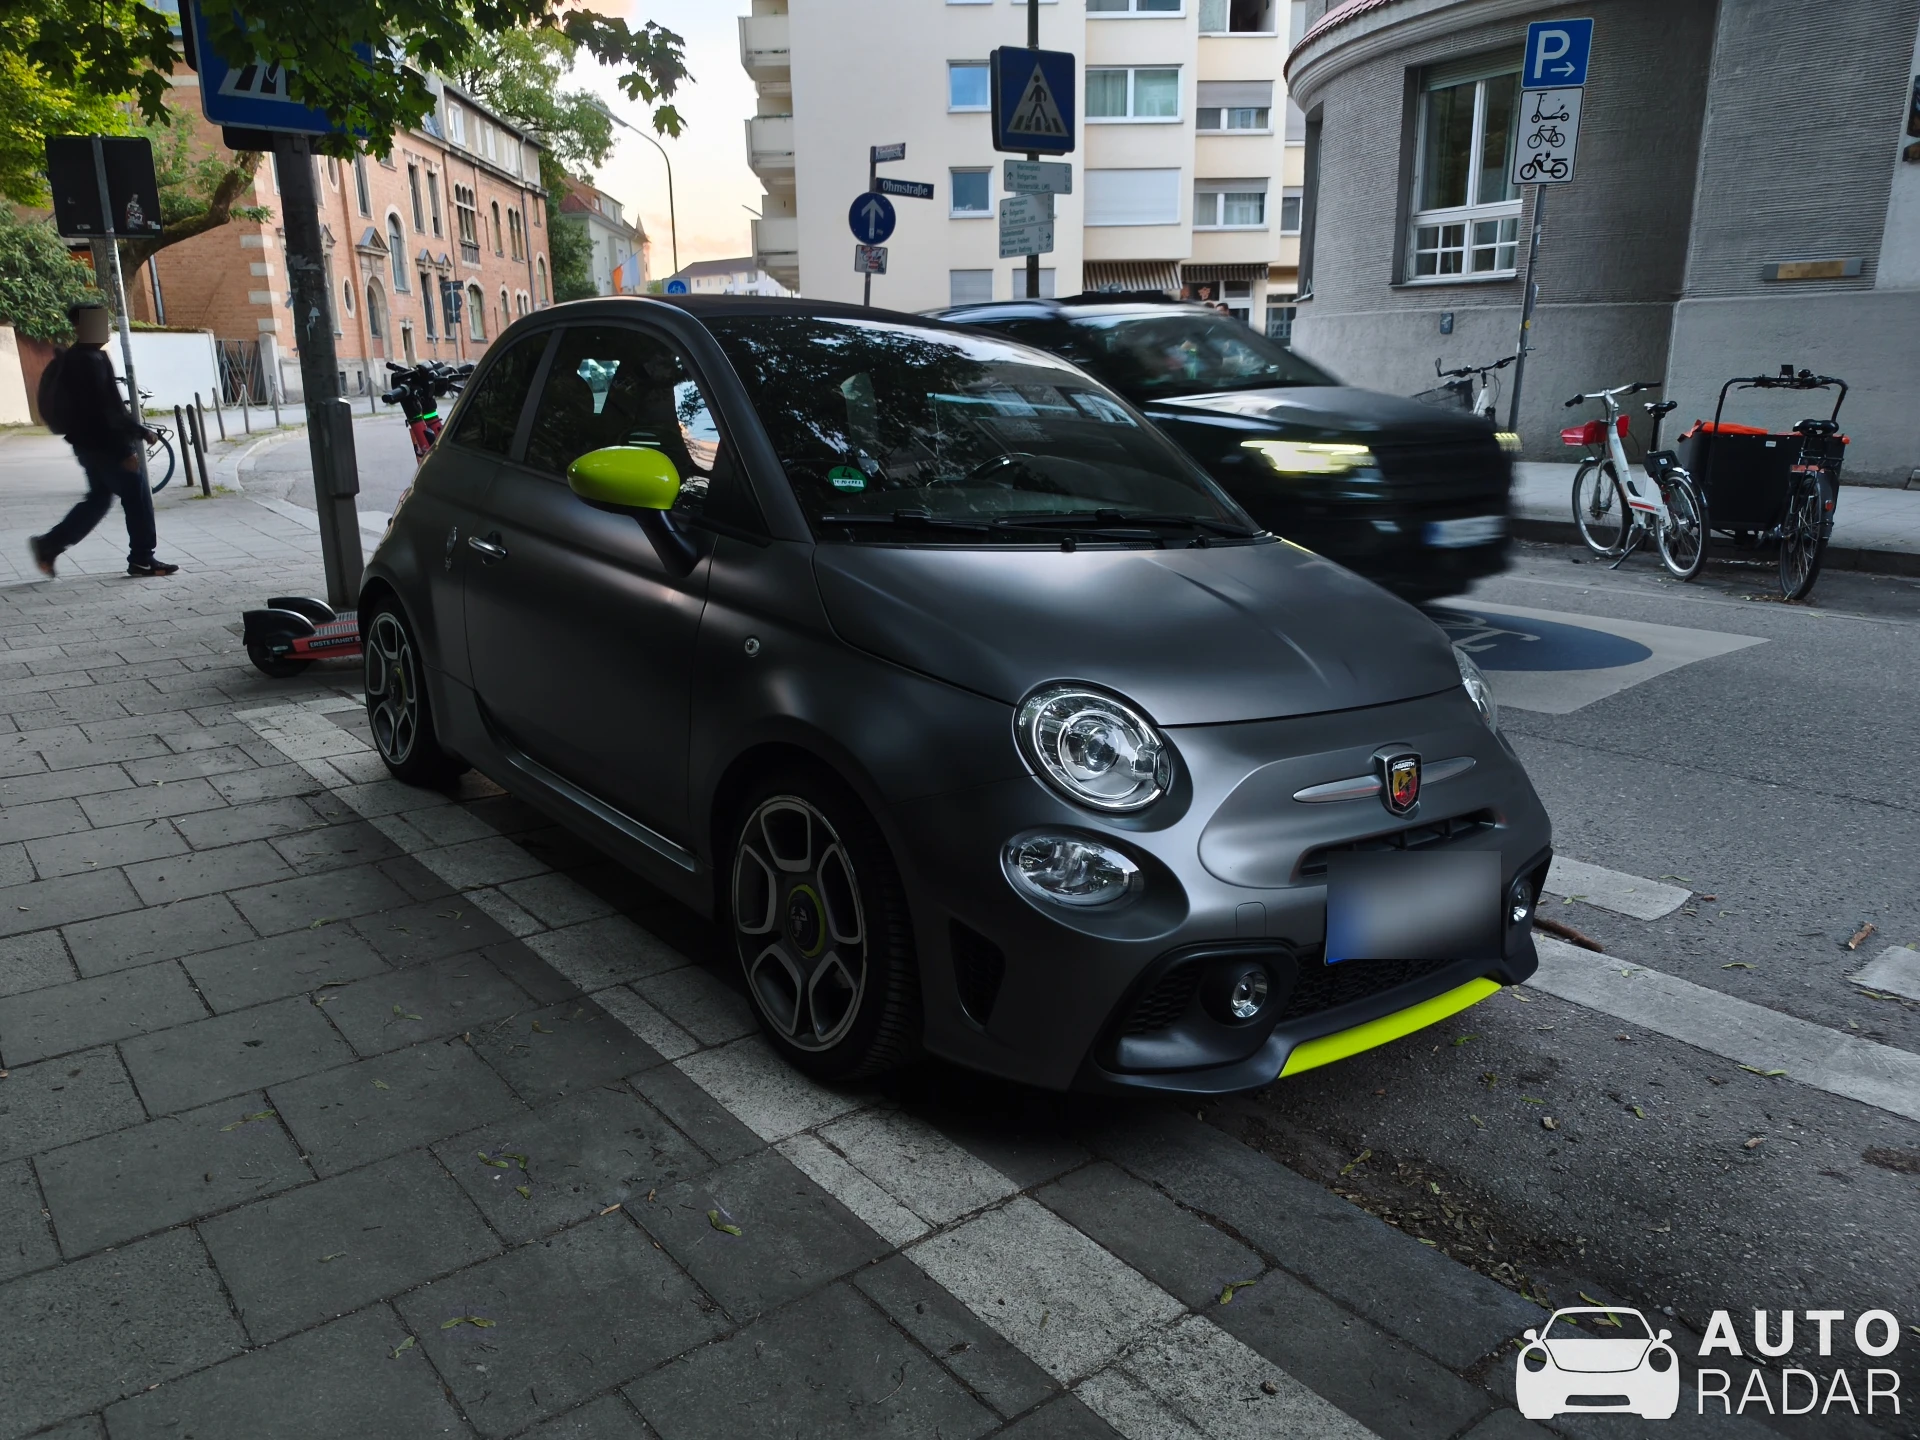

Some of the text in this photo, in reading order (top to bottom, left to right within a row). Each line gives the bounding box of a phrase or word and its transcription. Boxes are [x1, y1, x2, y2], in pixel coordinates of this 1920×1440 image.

[1534, 30, 1570, 78] P
[883, 180, 928, 196] Ohmstraße
[310, 640, 331, 648] ERSTE
[1394, 761, 1415, 770] ABARTH
